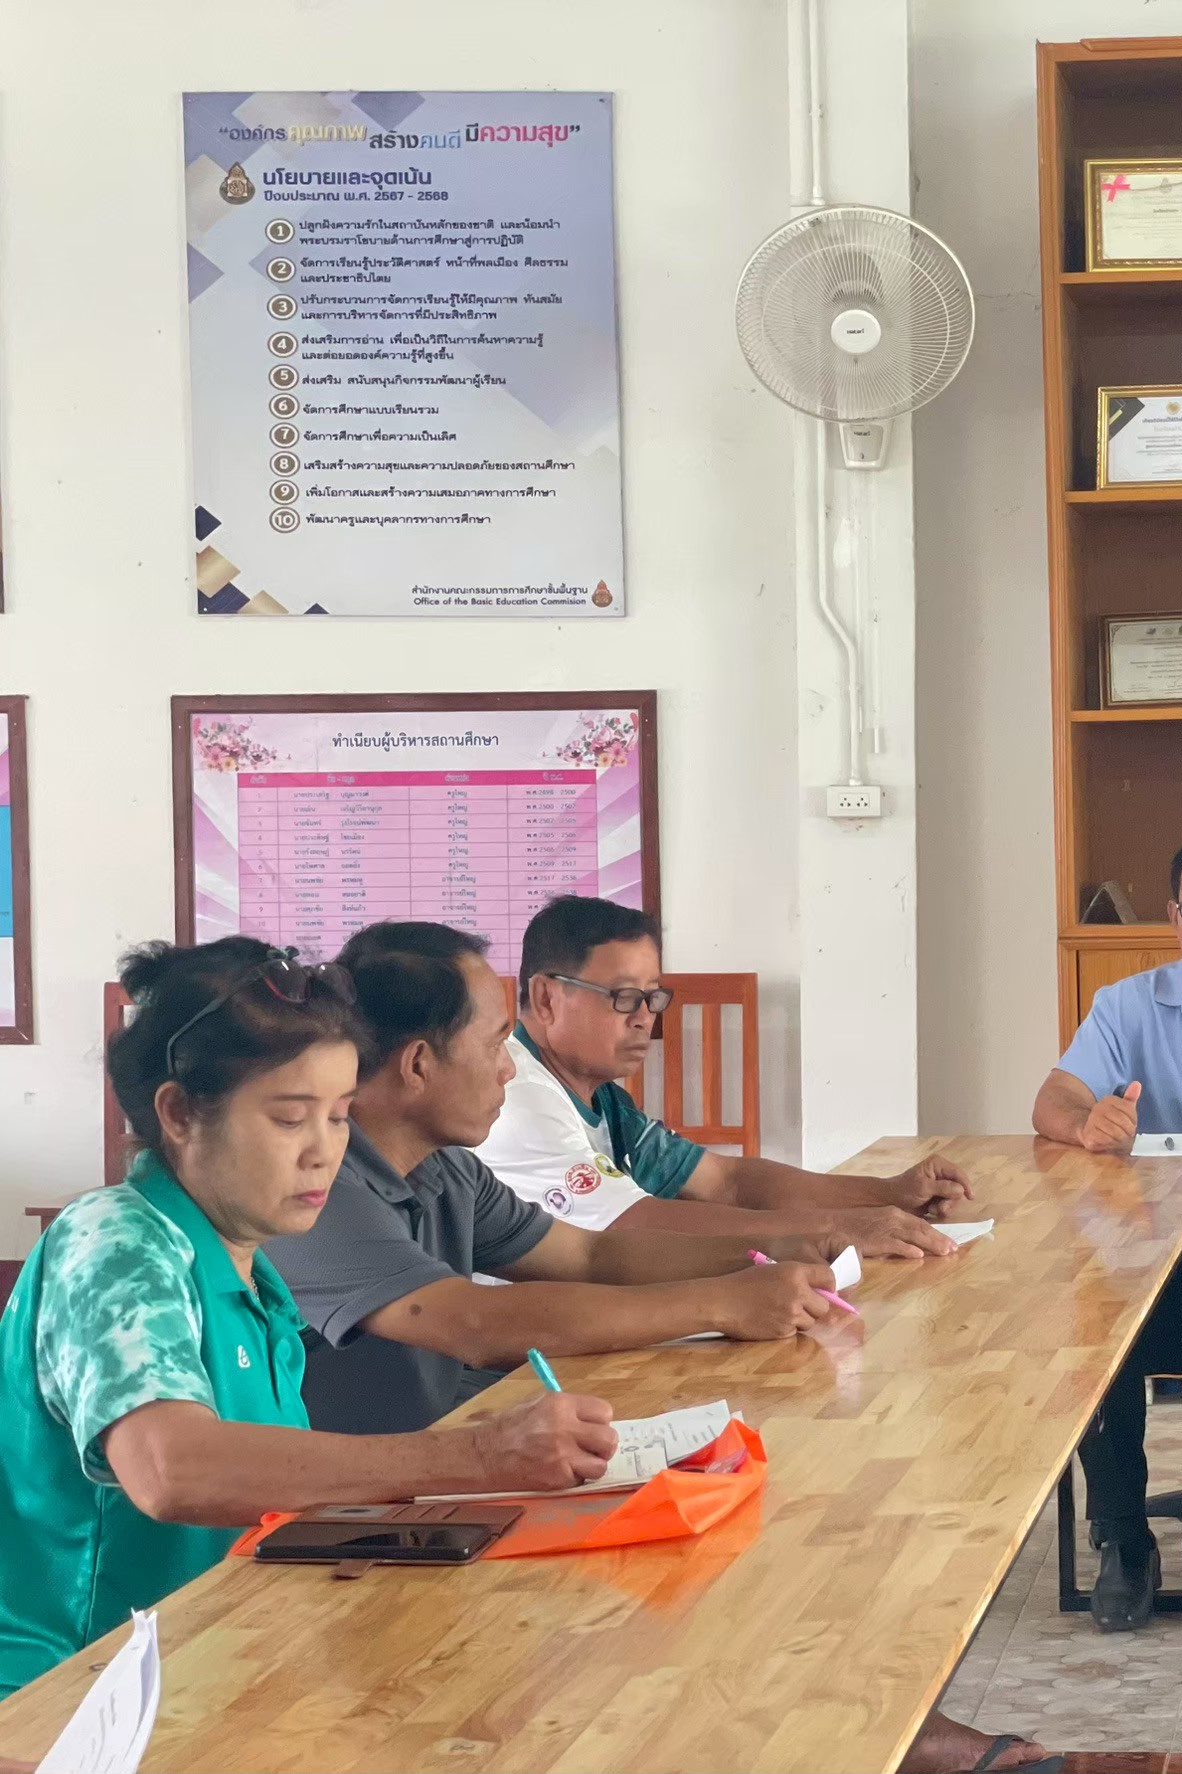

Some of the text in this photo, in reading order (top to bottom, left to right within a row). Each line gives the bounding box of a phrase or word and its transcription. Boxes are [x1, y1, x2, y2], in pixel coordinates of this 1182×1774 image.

[263, 167, 432, 190] นโยบายและจุดเน้น
[264, 190, 340, 201] ปีงบประมาณ
[343, 191, 371, 201] พ.ศ.
[374, 191, 404, 201] 2567
[417, 191, 448, 201] 2568
[276, 225, 284, 237] 1
[500, 218, 561, 229] และน้อมนำ
[277, 262, 287, 274] 2
[524, 257, 569, 267] ศีลธรรม
[300, 272, 391, 283] และประชาธิปไตย
[278, 301, 288, 313] 3
[523, 293, 563, 304] ทันสมัย
[277, 338, 287, 350] 4
[301, 334, 384, 345] ส่งเสริมการอ่าน
[279, 370, 289, 381] 5
[302, 374, 342, 385] ส่งเสริม
[278, 399, 439, 415] 6 จัดการศึกษาแบบเรียนรวม
[280, 428, 457, 441] 7 จัดการศึกษาเพื่อความเป็นเลิศ
[279, 458, 289, 469] 8
[280, 485, 290, 497] 9
[276, 513, 491, 527] 10 พัฒนาครูและบุคลากรทางการศึกษา
[413, 598, 440, 606] Office
[442, 597, 452, 606] of
[454, 597, 468, 606] the
[471, 597, 493, 606] Basic
[496, 597, 538, 606] Education
[332, 731, 500, 752] ทำเนียบผู้บริหารสถานศึกษา
